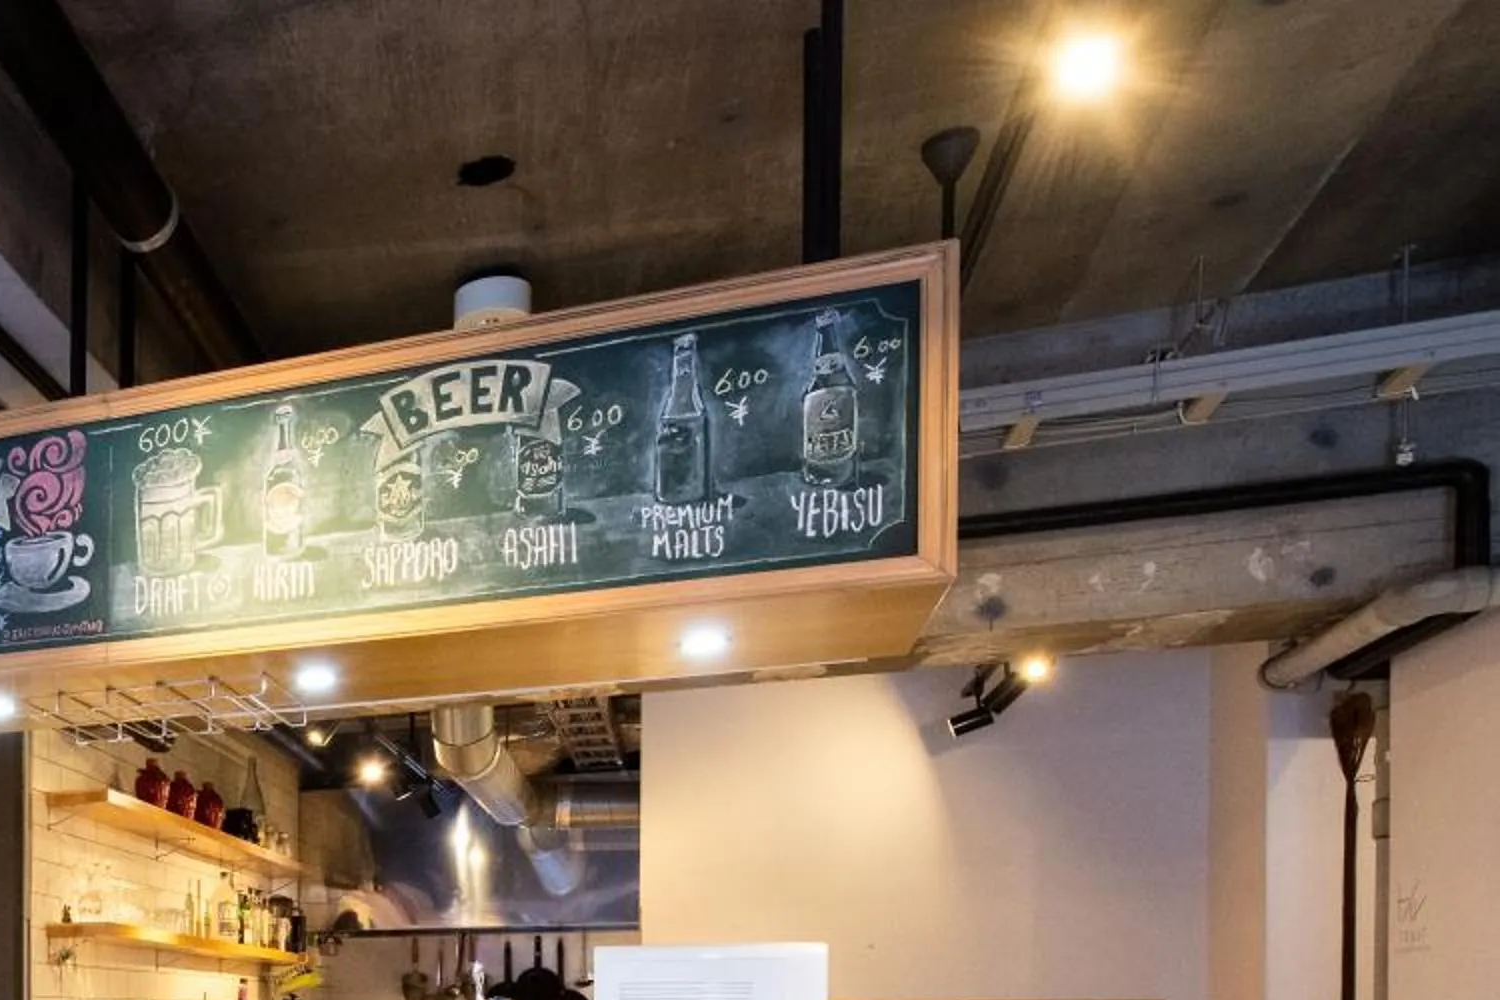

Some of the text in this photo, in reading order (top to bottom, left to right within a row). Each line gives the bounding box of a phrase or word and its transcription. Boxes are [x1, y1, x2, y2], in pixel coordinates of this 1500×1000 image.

[853, 336, 902, 359] 600
[391, 364, 533, 435] BEER
[715, 368, 769, 395] 600
[566, 404, 623, 431] 600
[641, 494, 733, 529] PREMIUM
[791, 484, 883, 538] YEBISU
[504, 522, 578, 570] ASAHI
[652, 525, 725, 559] MALTS
[361, 538, 459, 589] SAPPORO
[134, 573, 200, 616] DRAFT
